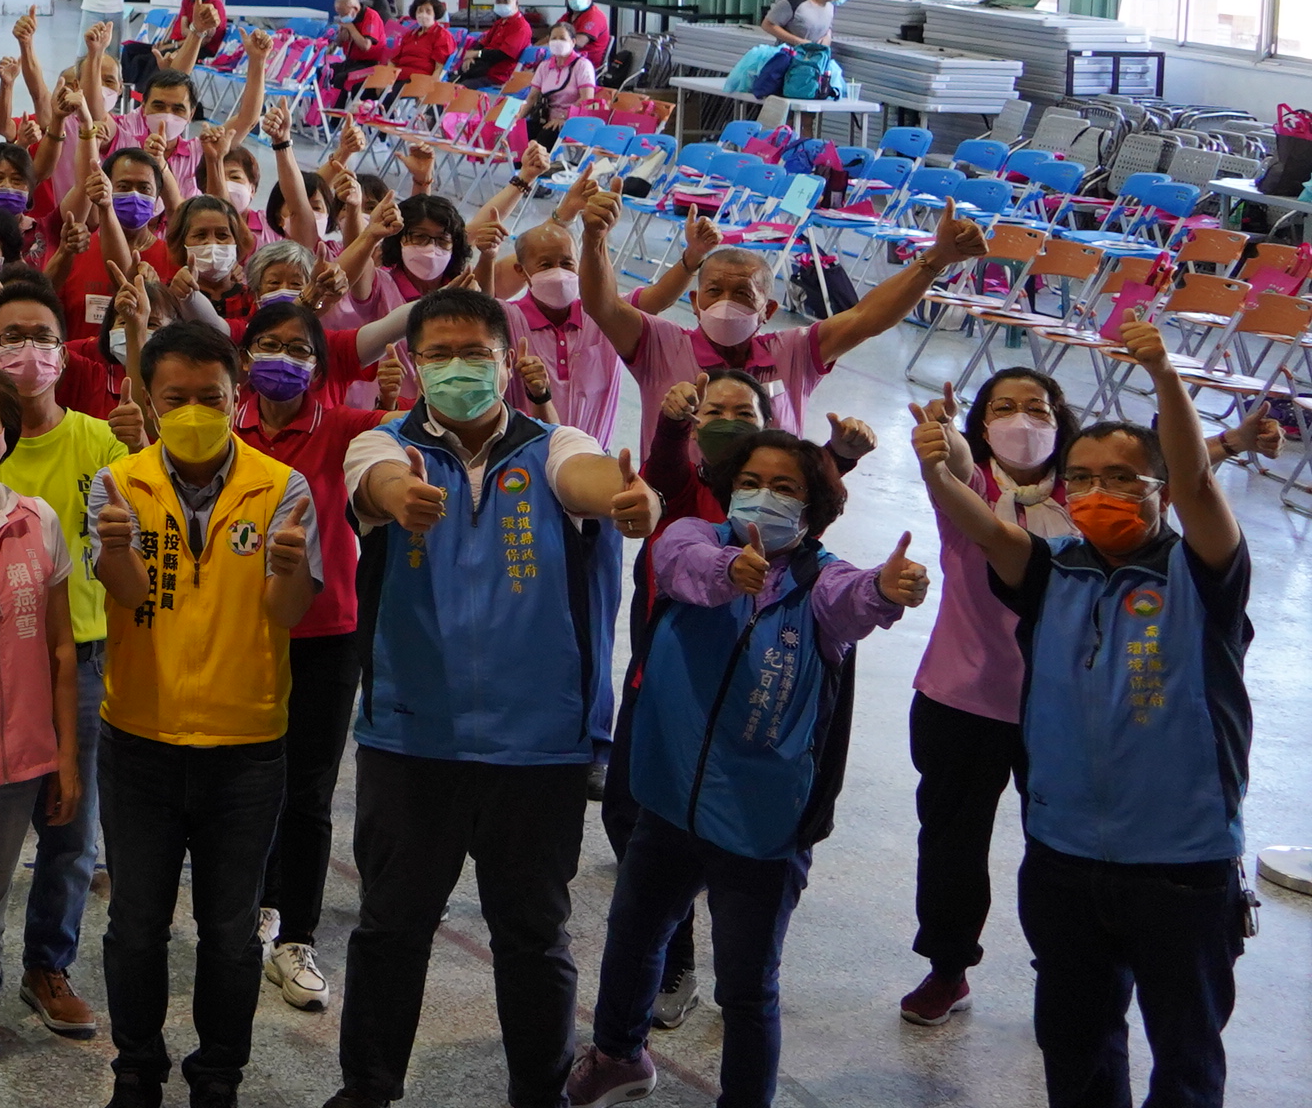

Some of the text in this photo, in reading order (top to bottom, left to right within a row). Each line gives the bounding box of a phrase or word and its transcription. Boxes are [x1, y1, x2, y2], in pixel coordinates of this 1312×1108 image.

[160, 514, 180, 611] 南投縣議員
[501, 516, 523, 594] 環境保護局
[516, 501, 537, 578] 南投縣政府
[6, 562, 38, 640] 賴燕雪
